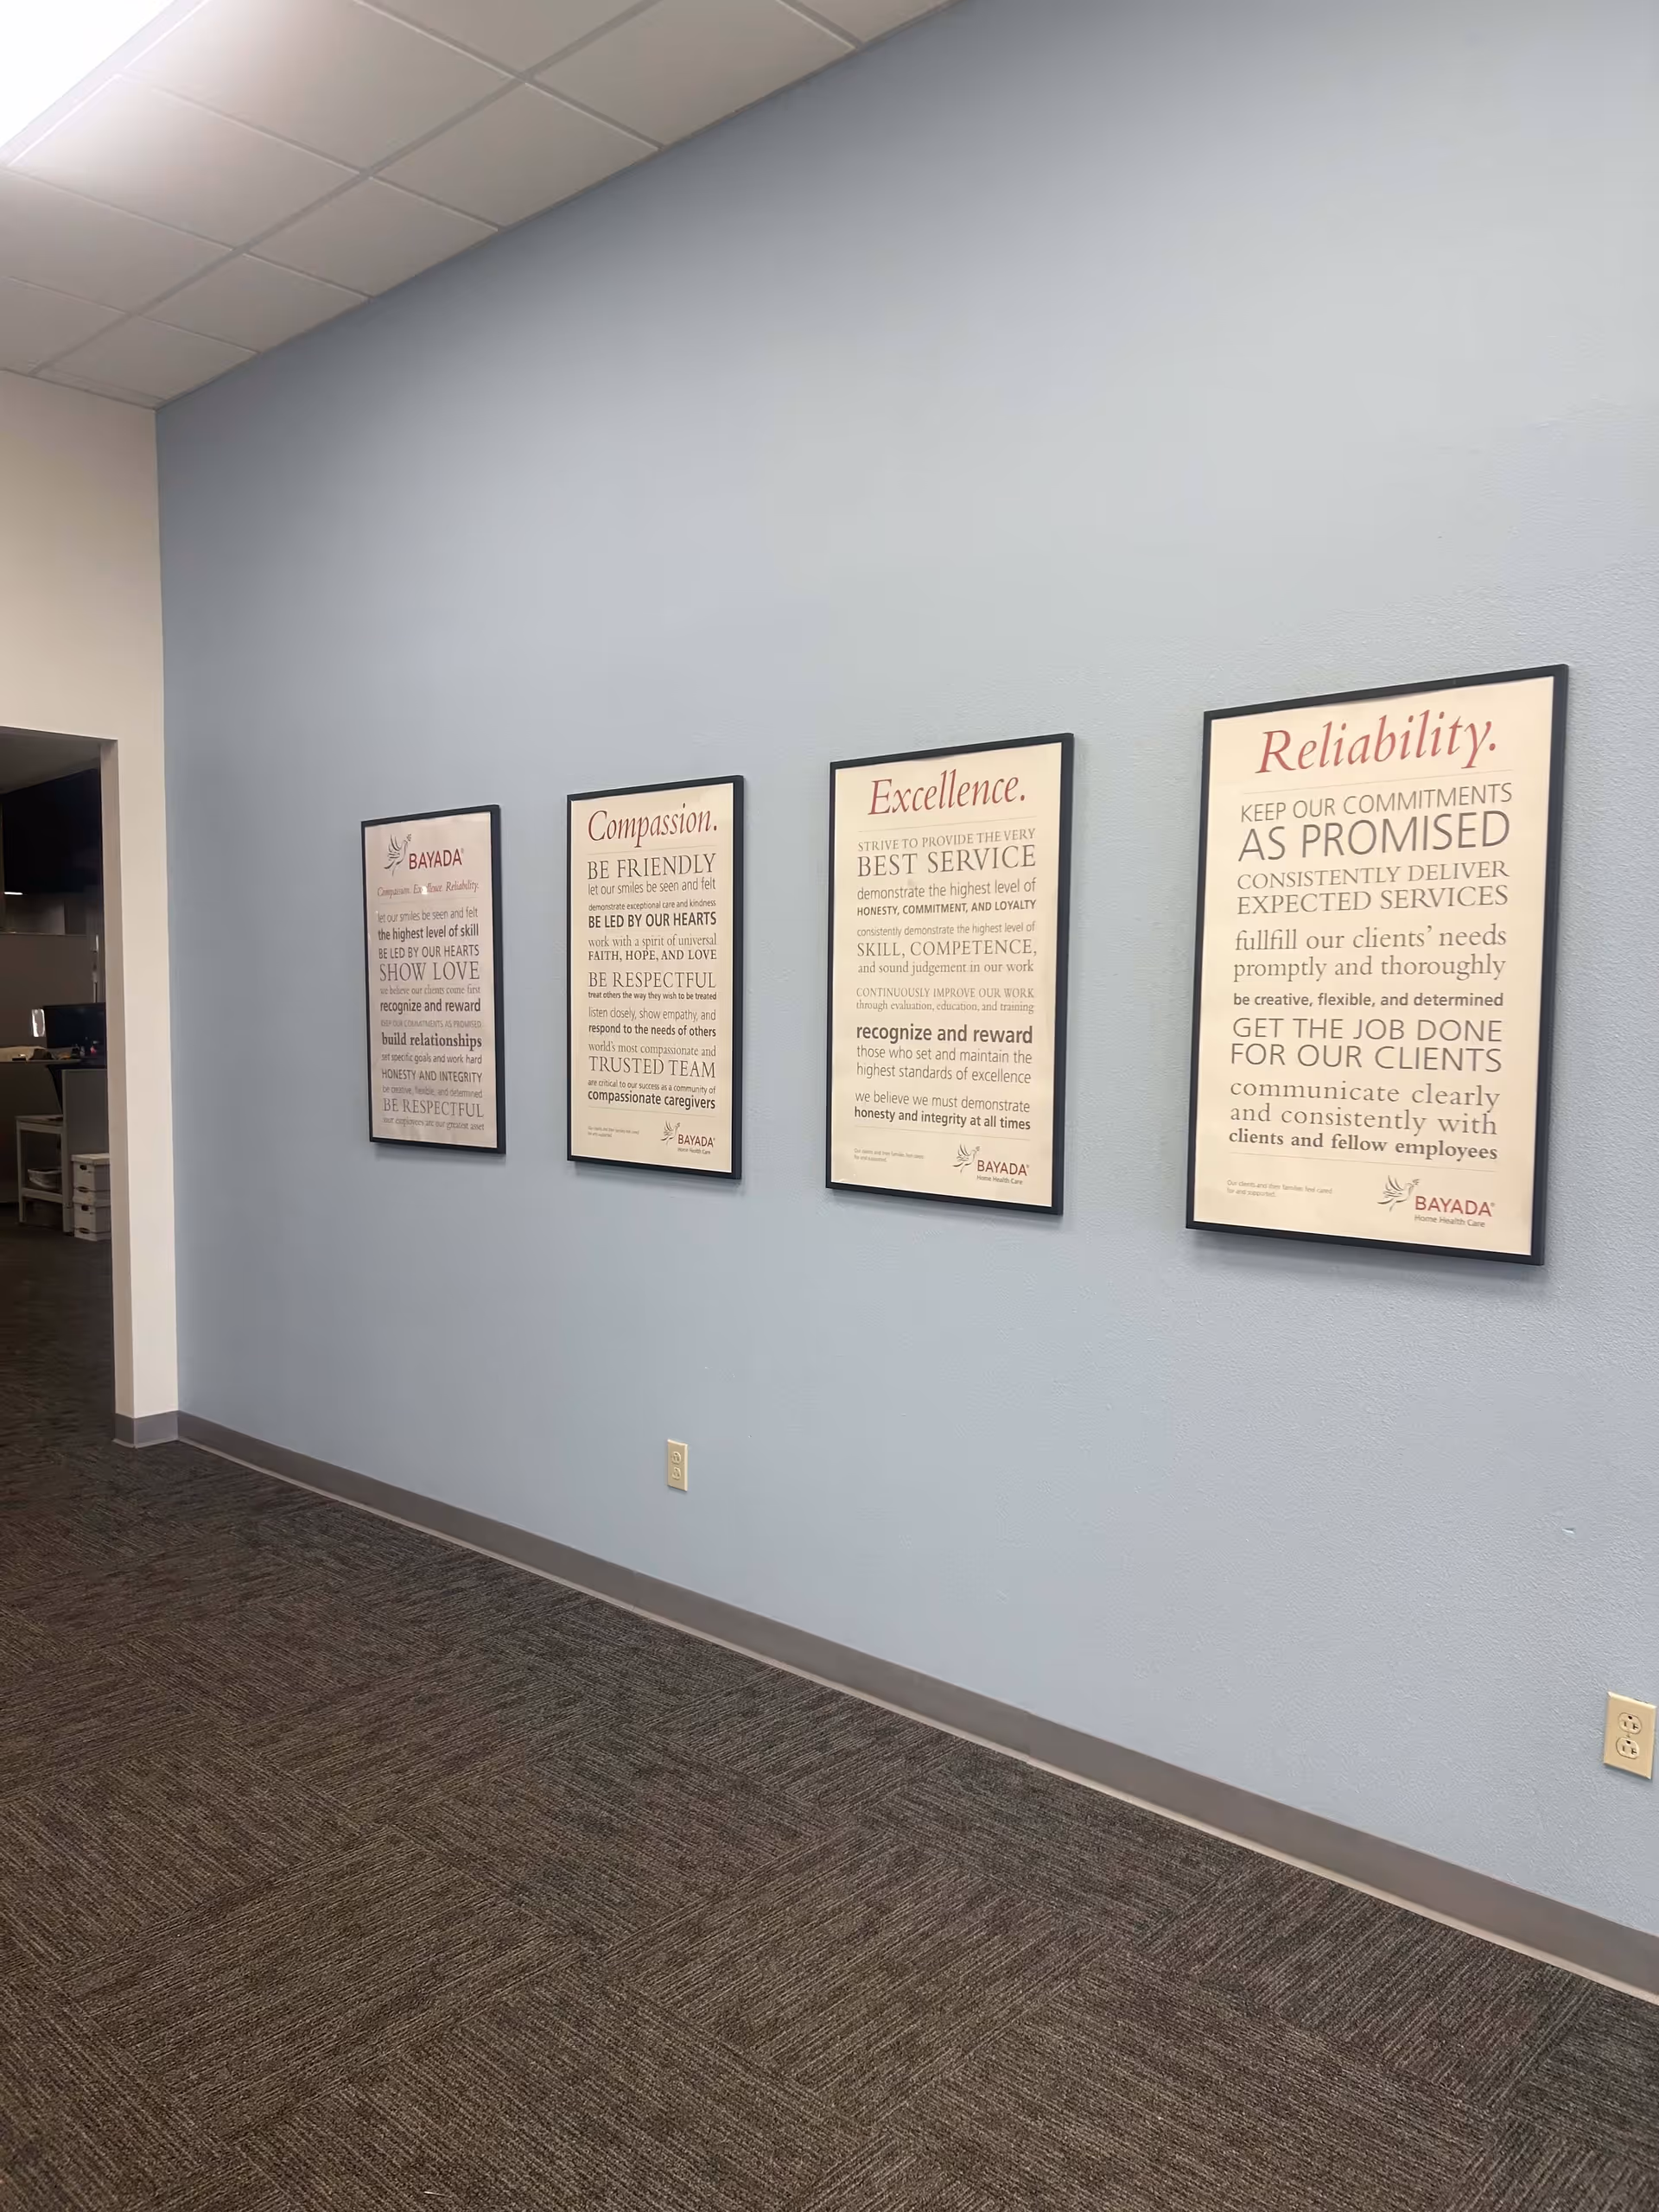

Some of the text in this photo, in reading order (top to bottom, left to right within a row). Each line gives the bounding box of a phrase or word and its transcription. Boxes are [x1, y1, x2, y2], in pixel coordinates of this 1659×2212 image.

[1255, 709, 1496, 773] Reliability.
[868, 768, 1025, 815] Excellence.
[1241, 782, 1512, 823] KEEP OUR COMMITMENTS
[588, 802, 716, 848] Compassion.
[1237, 810, 1510, 861] AS PROMISED
[857, 828, 1035, 852] STRIVE TO PROVIDE THE VERY
[587, 853, 716, 880] BE FRIENDLY
[857, 844, 1035, 877] BEST SERVICE
[1236, 860, 1510, 890] CONSISTENTLY DELIVER
[856, 876, 1037, 899] demonstrate the highest level of
[1236, 884, 1508, 914] EXPECTED SERVICES
[856, 899, 1036, 916] HONESTY, COMMITMENT, AND LOYALTY
[588, 911, 716, 928] BE LED BY OUR HEARTS
[378, 922, 479, 942] the highest level of skill
[1235, 928, 1297, 950] fullfill
[1306, 935, 1344, 949] our
[1439, 922, 1506, 946] needs
[378, 944, 480, 959] BE LED BY OUR HEARTS
[588, 949, 716, 962] FAITH, HOPE, AND LOVE
[857, 938, 1036, 958] SKILL, COMPETENCE,
[379, 961, 480, 981] SHOW LOVE
[857, 959, 1033, 976] and sound judgement in our work
[1233, 952, 1506, 982] promptly and thoroughly
[588, 971, 716, 988] BE RESPECTFUL
[855, 987, 1034, 998] CONTINUOUSLY IMPROVE OUR WORK
[1233, 992, 1503, 1007] be creative, flexible, and determined
[379, 997, 480, 1014] recognize and reward
[588, 1022, 716, 1037] respond to the needs of others
[856, 1023, 1033, 1044] recognize and reward
[1232, 1017, 1502, 1042] GET THE JOB DONE
[381, 1032, 482, 1051] build relationships
[588, 1055, 715, 1077] TRUSTED TEAM
[1231, 1043, 1501, 1072] FOR OUR CLIENTS
[381, 1068, 482, 1084] HONESTY AND INTEGRITY
[856, 1061, 1031, 1084] highest standards of excellence
[382, 1097, 484, 1118] BE RESPECTFUL
[588, 1090, 715, 1110] compassionate caregivers
[855, 1090, 1030, 1113] we believe we must demonstrate
[1230, 1080, 1500, 1112] communicate clearly
[854, 1105, 1030, 1129] honesty and integrity at all times
[1230, 1102, 1497, 1136] and consistently with
[1229, 1128, 1497, 1161] clients and fellow employees
[1414, 1214, 1485, 1228] Home Health Care
